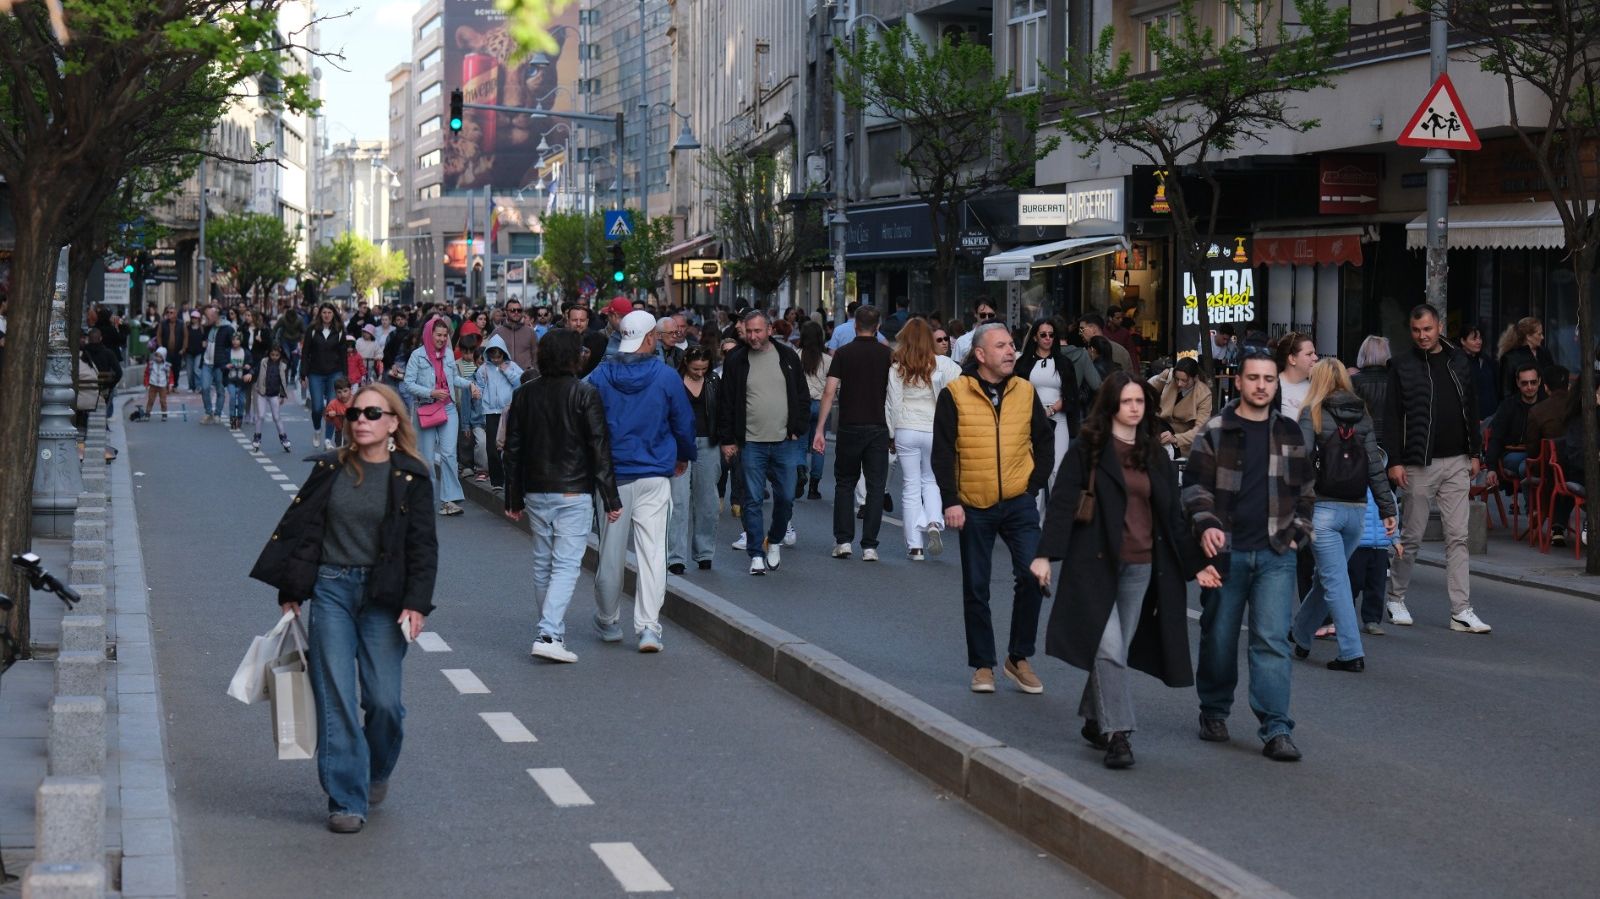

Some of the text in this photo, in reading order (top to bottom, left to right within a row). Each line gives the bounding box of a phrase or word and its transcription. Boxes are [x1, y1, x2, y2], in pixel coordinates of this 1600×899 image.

[1023, 204, 1065, 213] BURGERATI
[1068, 189, 1115, 224] BURGERATI
[1223, 246, 1231, 257] by
[1183, 268, 1254, 299] UTRA
[1185, 286, 1251, 309] sashed
